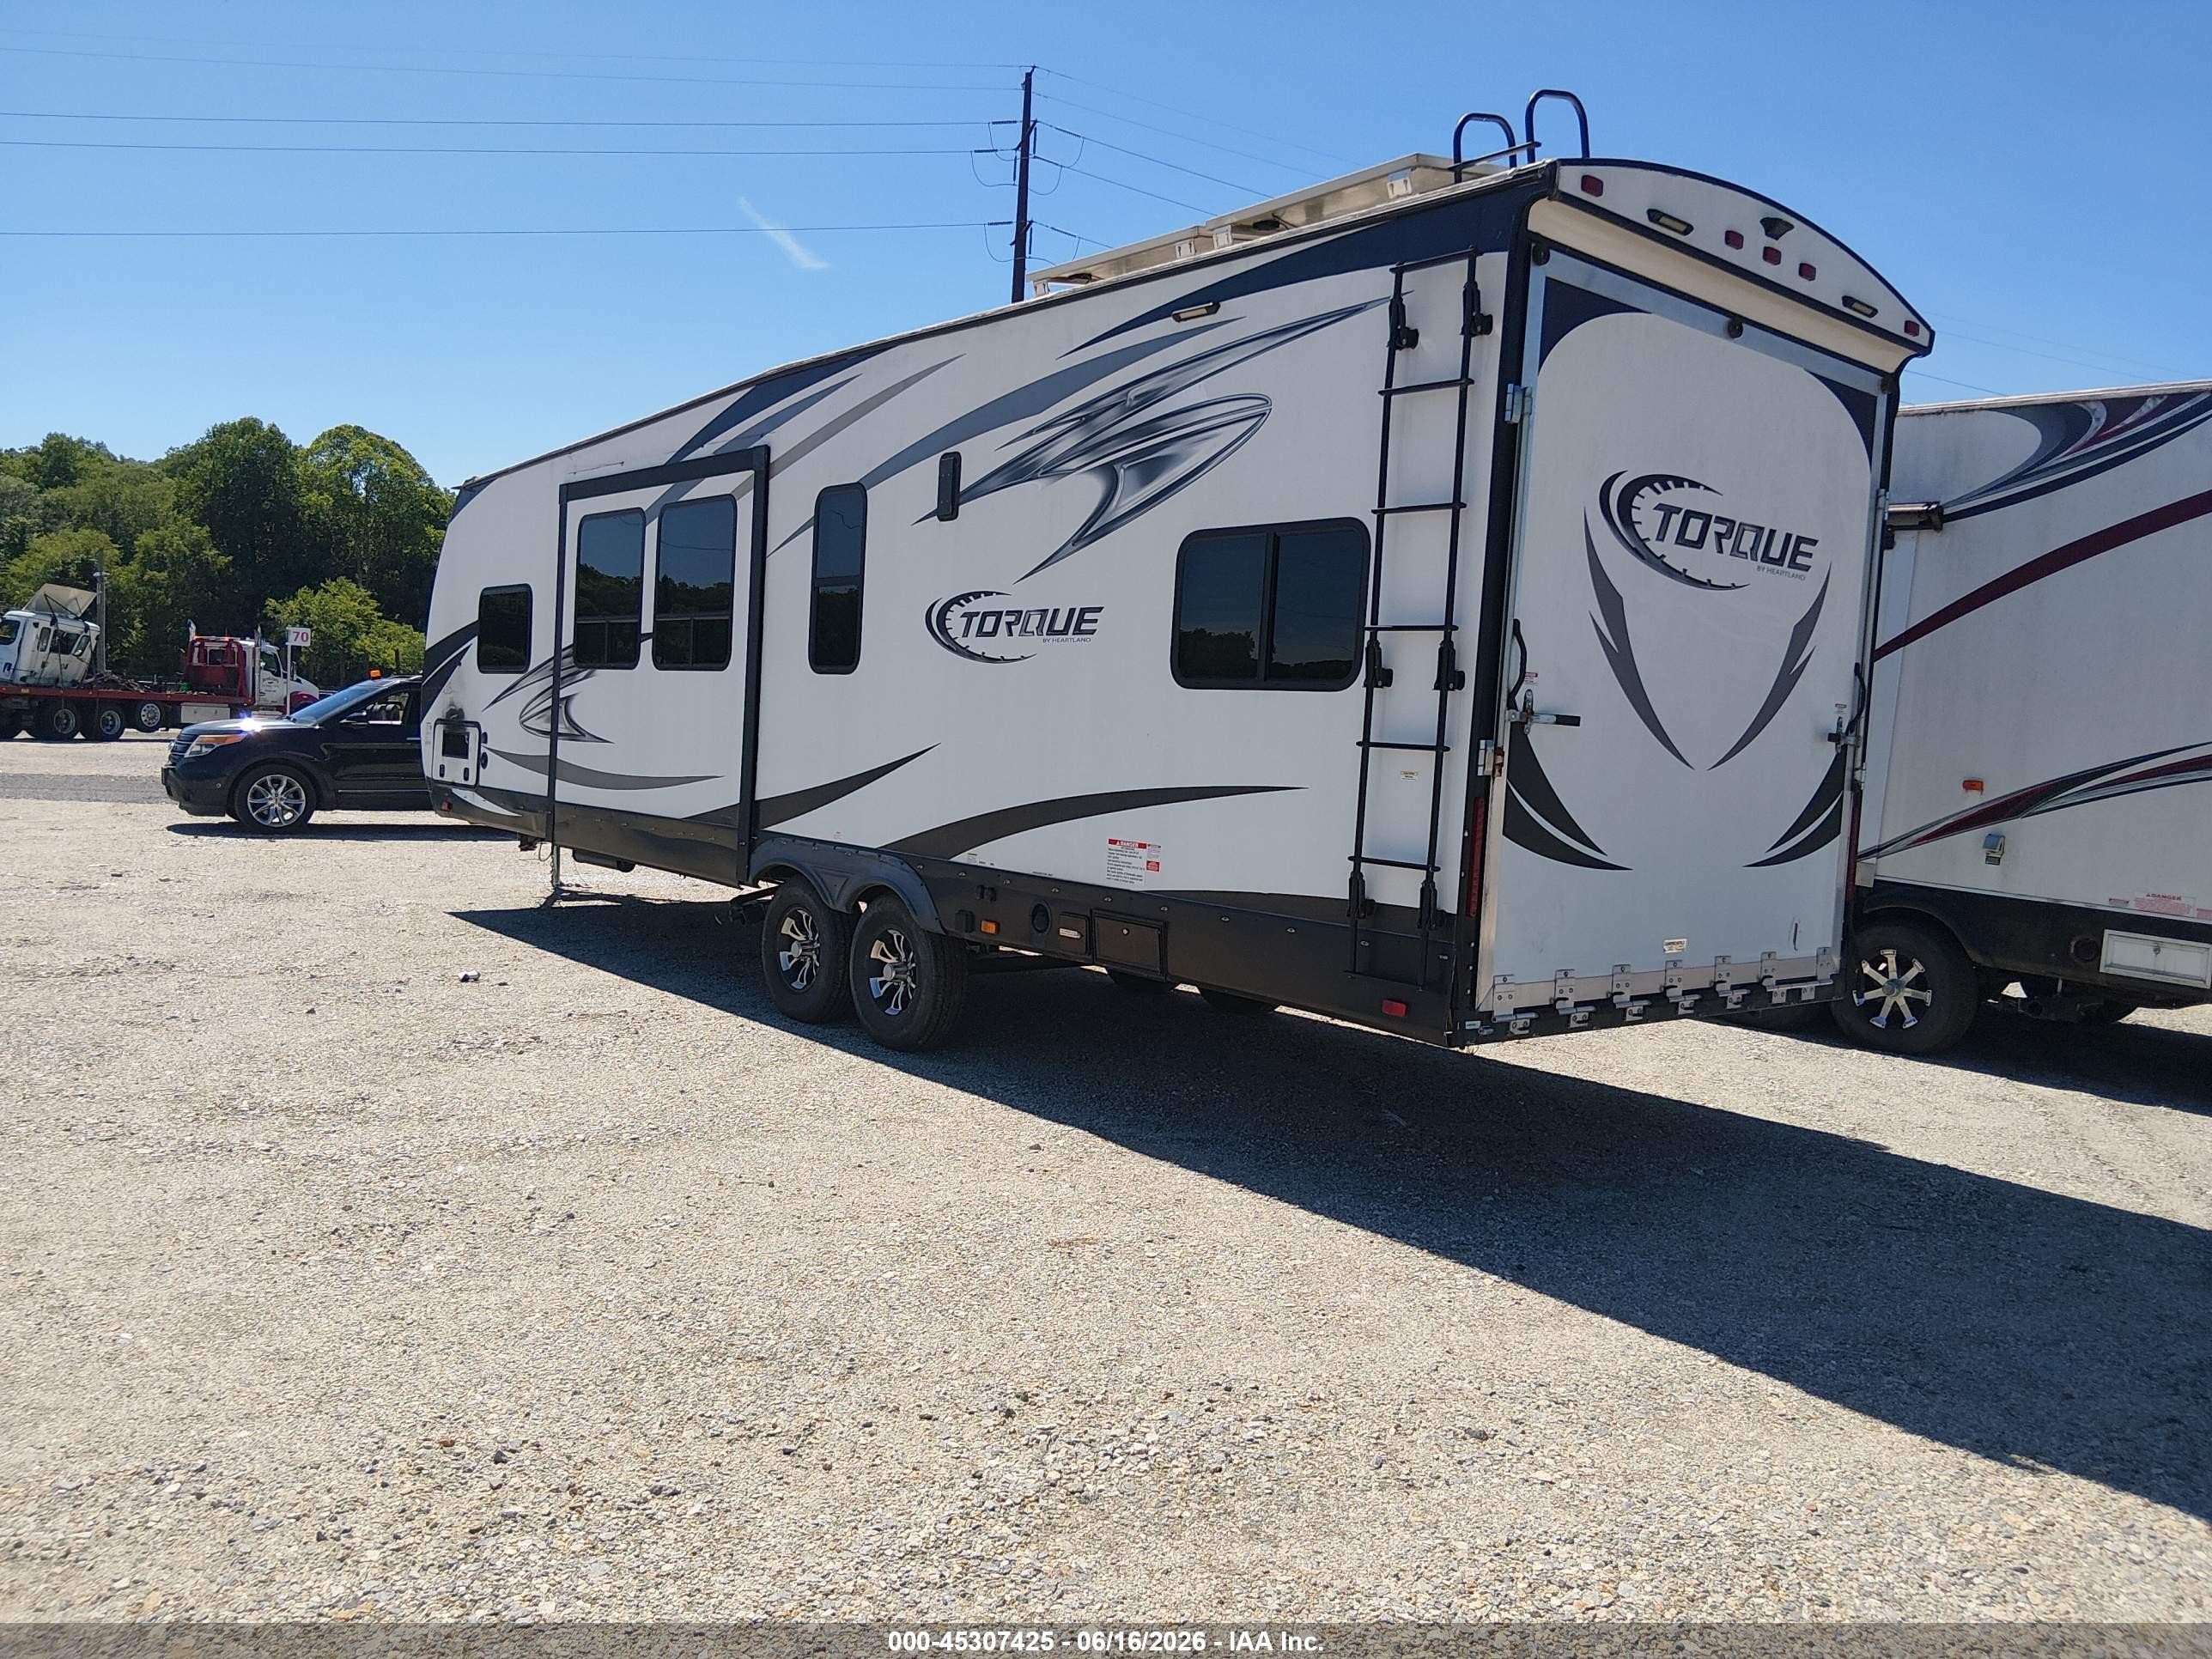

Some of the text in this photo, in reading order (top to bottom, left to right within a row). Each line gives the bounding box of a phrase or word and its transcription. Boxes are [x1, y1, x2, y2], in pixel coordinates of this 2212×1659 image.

[1653, 502, 1820, 572] TORQUE
[1766, 567, 1806, 580] HEARTLAND
[960, 606, 1104, 638] TORQUE
[292, 631, 309, 642] 70
